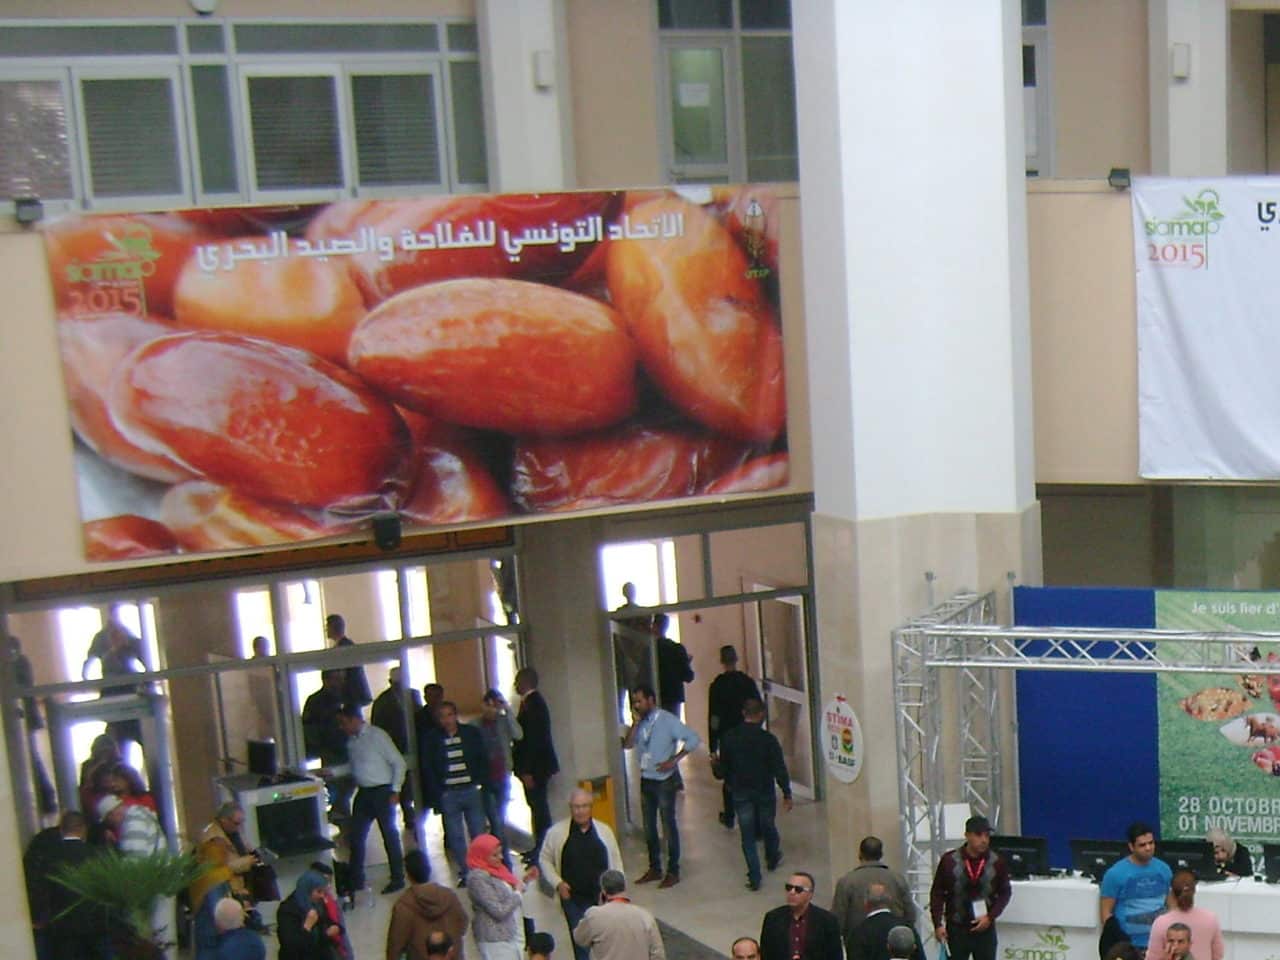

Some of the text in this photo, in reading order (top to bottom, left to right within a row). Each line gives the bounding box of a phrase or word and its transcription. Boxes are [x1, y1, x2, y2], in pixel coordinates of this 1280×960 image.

[400, 219, 497, 251] للفلاحة
[503, 214, 604, 262] التونسي
[1145, 215, 1221, 238] siamap
[295, 227, 395, 262] والصيد
[1147, 243, 1206, 269] 2015
[68, 288, 141, 316] 2015
[1191, 601, 1208, 614] Je
[1212, 602, 1237, 615] suis
[1239, 602, 1262, 615] fier
[1178, 796, 1201, 814] 28
[1179, 814, 1198, 832] 01
